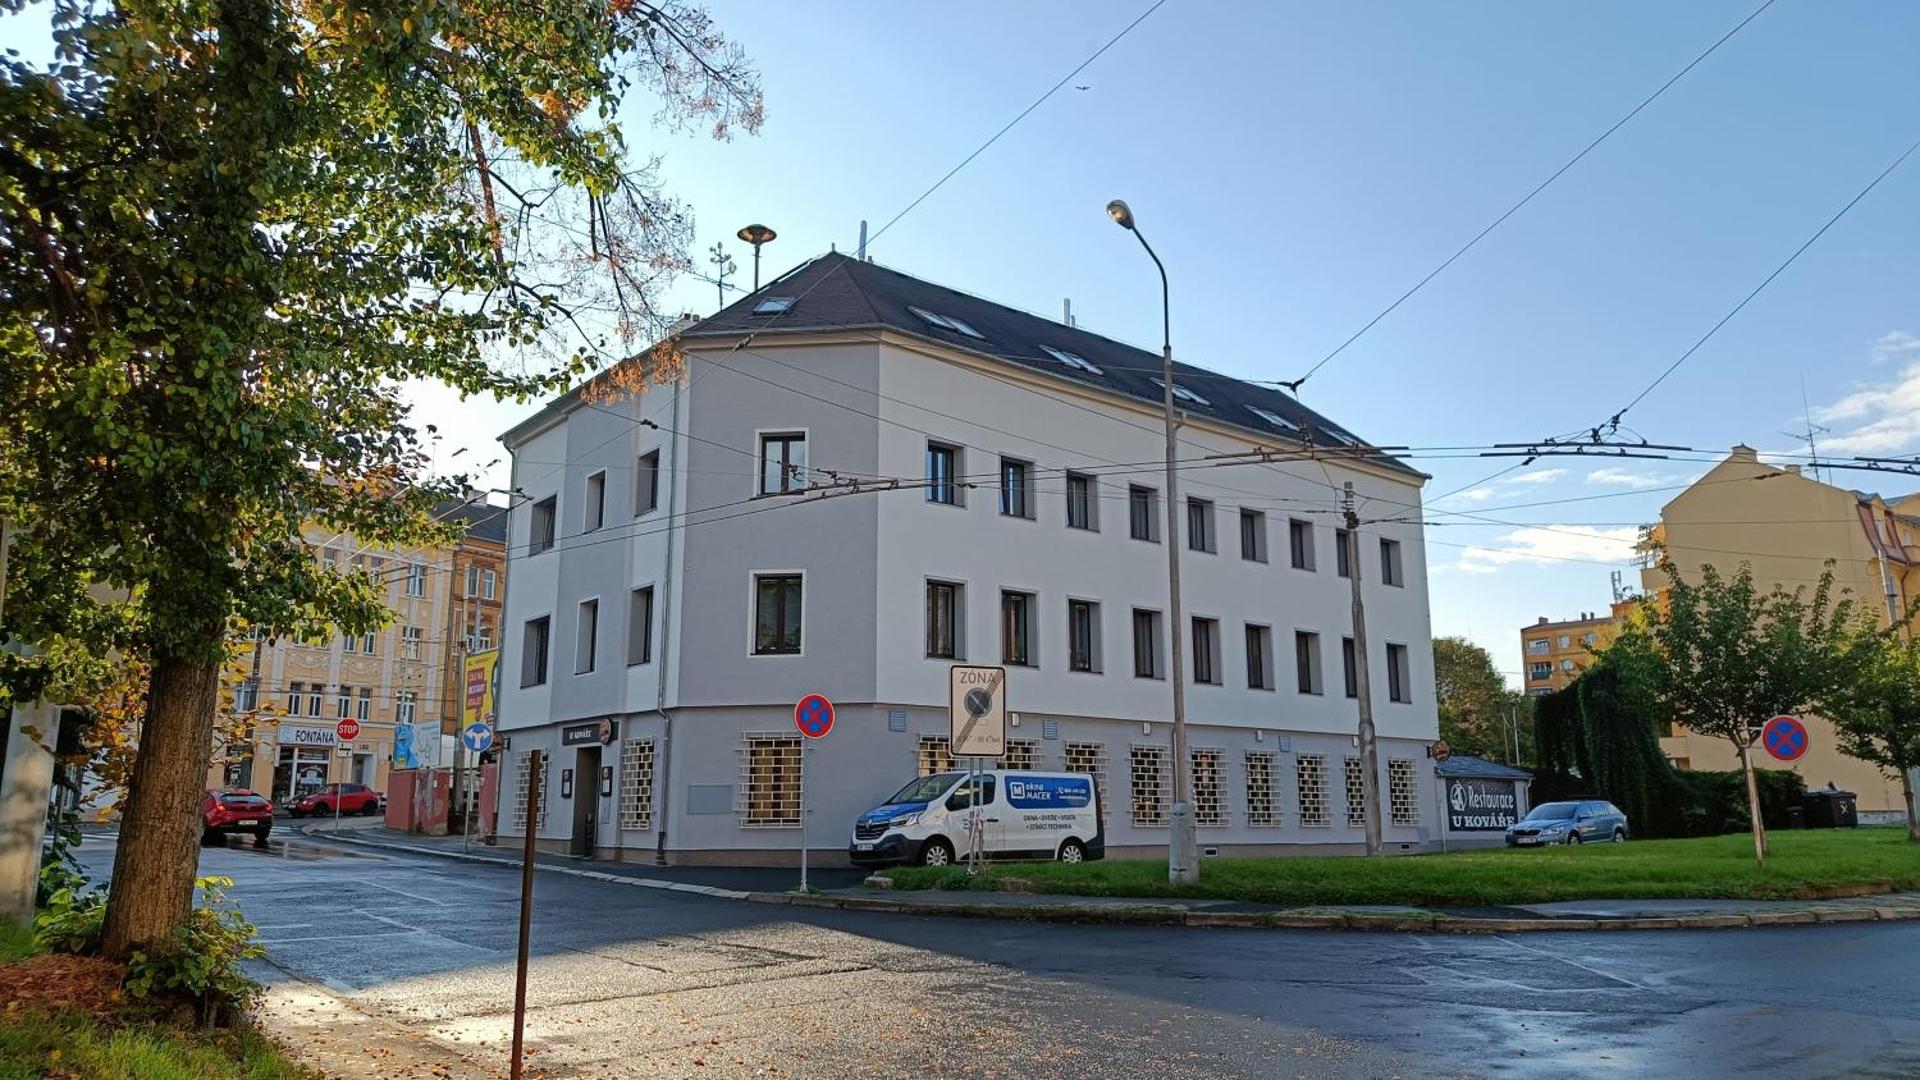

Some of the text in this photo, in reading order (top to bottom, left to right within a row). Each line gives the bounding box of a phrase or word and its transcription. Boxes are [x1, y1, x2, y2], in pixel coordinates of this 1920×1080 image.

[960, 669, 997, 684] ZÓNA
[338, 725, 358, 734] STOP
[1026, 791, 1052, 800] MACEK
[1467, 782, 1514, 809] Restaurace
[1452, 812, 1515, 828] U KOVÁŘE
